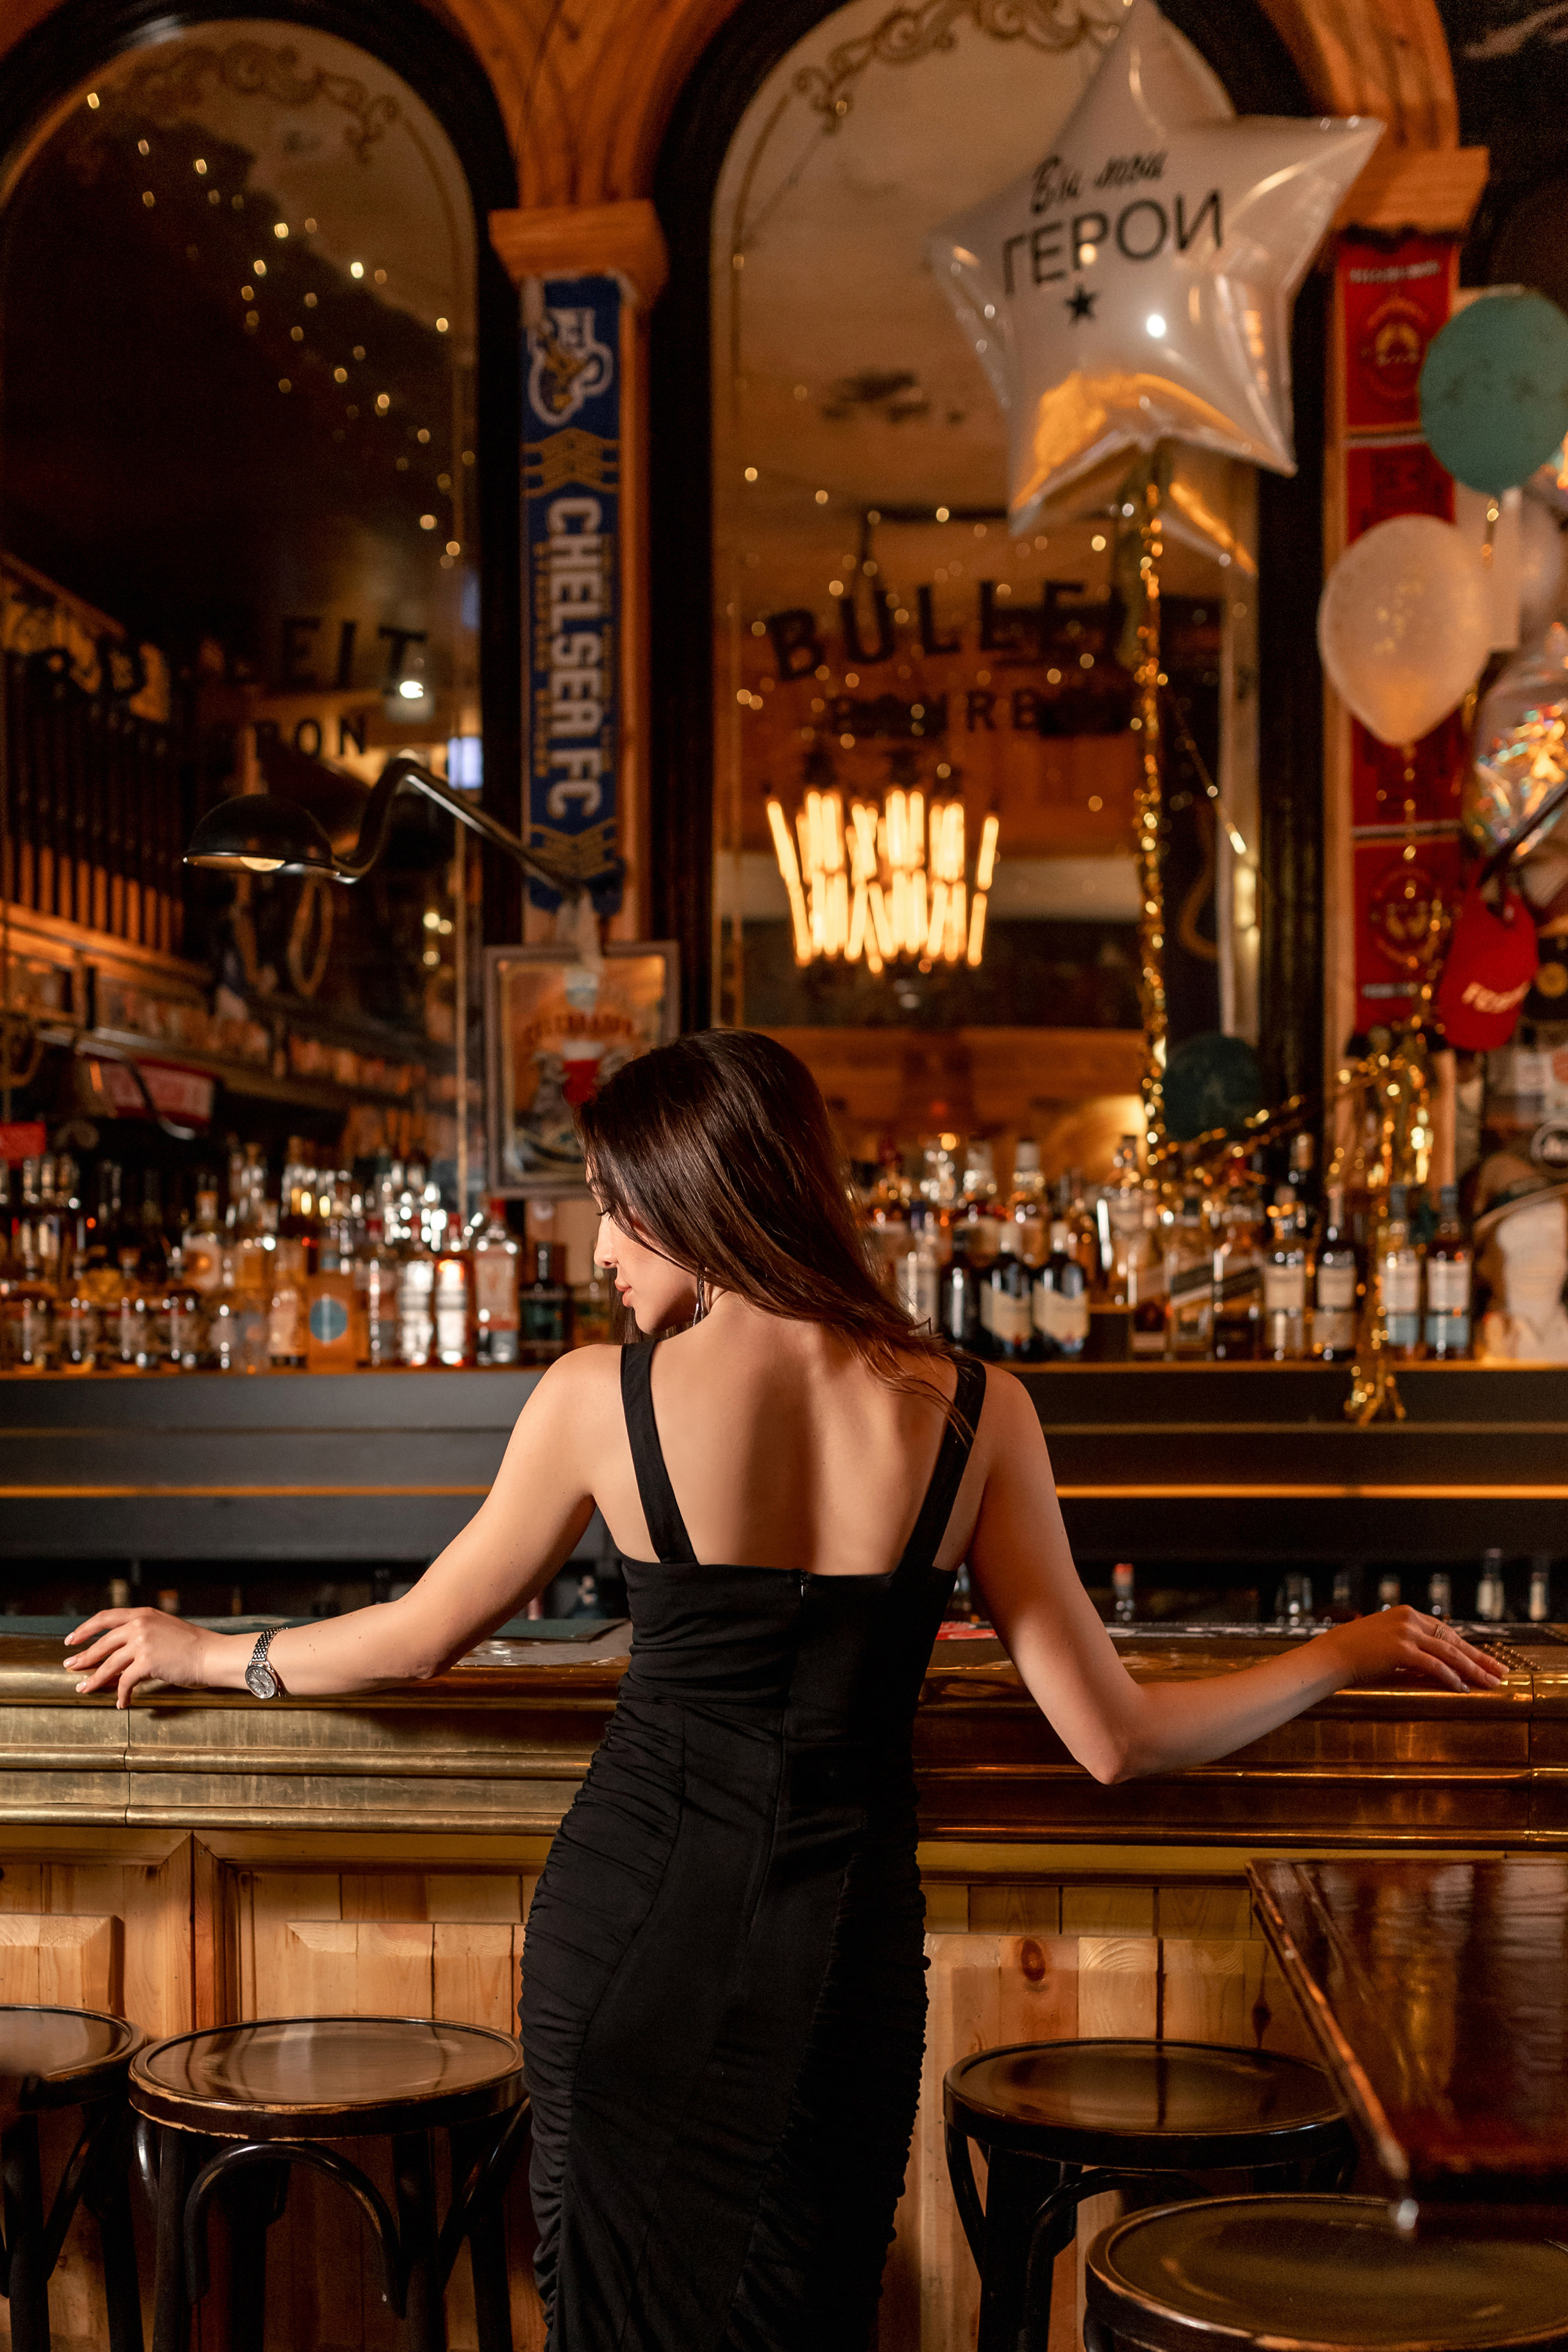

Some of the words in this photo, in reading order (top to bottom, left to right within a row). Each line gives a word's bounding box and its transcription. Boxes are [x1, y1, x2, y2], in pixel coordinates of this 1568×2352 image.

[1002, 187, 1224, 299] ГЕРОИ
[546, 496, 604, 737] CHELSEA
[546, 748, 604, 820] FC
